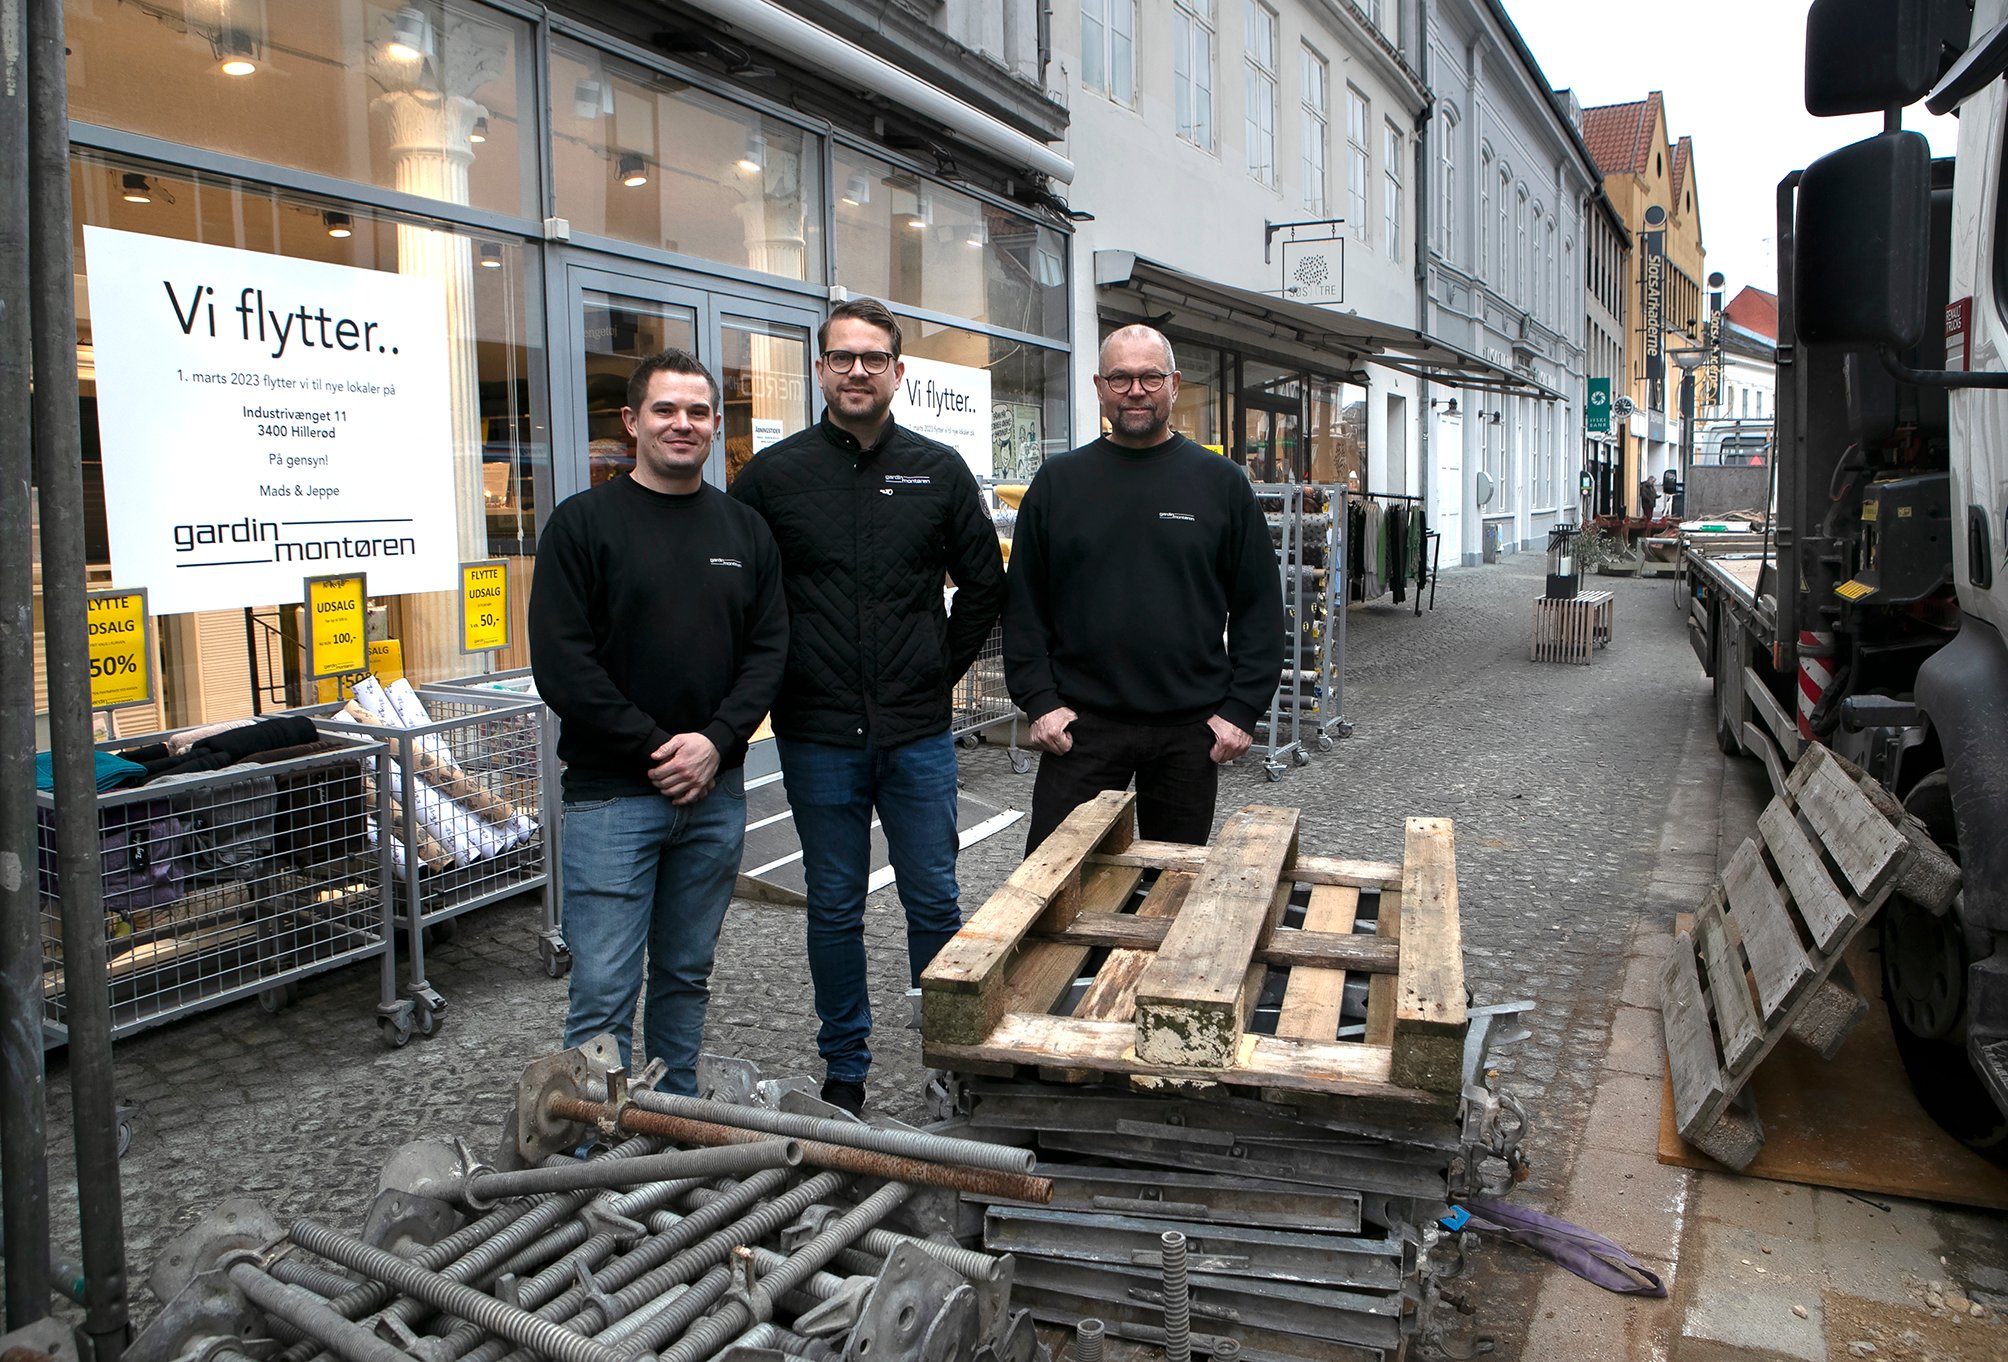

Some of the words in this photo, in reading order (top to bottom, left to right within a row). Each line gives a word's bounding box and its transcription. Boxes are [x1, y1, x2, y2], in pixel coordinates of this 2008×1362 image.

[1647, 254, 1660, 357] SlotsArkaderne
[1945, 305, 1961, 321] RENAULT
[163, 280, 216, 337] Vi
[235, 287, 399, 359] flytter..
[1945, 318, 1961, 332] TRUCKS
[177, 369, 188, 382] 1.
[192, 372, 227, 384] marts
[231, 372, 260, 387] 2023
[263, 374, 296, 390] flytter
[300, 378, 309, 390] vi
[312, 378, 322, 390] til
[326, 381, 344, 395] nye
[347, 381, 380, 395] lokaler
[383, 384, 396, 397] på
[906, 378, 921, 407] Vi
[926, 379, 976, 417] flytter..
[243, 406, 331, 423] Industrivænget
[334, 411, 347, 422] 11
[258, 424, 288, 437] 3400
[291, 425, 336, 439] Hillerød
[269, 453, 283, 465] På
[287, 455, 329, 469] gensyn!
[260, 484, 291, 497] Mads
[294, 485, 304, 497] &
[306, 485, 340, 500] Jeppe
[174, 517, 279, 552] gardin
[275, 537, 416, 562] montøren
[471, 569, 498, 580] FLYTTE
[469, 587, 501, 599] UDSALG
[87, 596, 129, 611] LYTTE
[317, 600, 355, 613] UDSALG
[88, 620, 135, 636] DSALG
[480, 613, 500, 627] 50,-
[333, 632, 357, 645] 100,-
[368, 646, 389, 655] SALG
[90, 654, 137, 678] 50%
